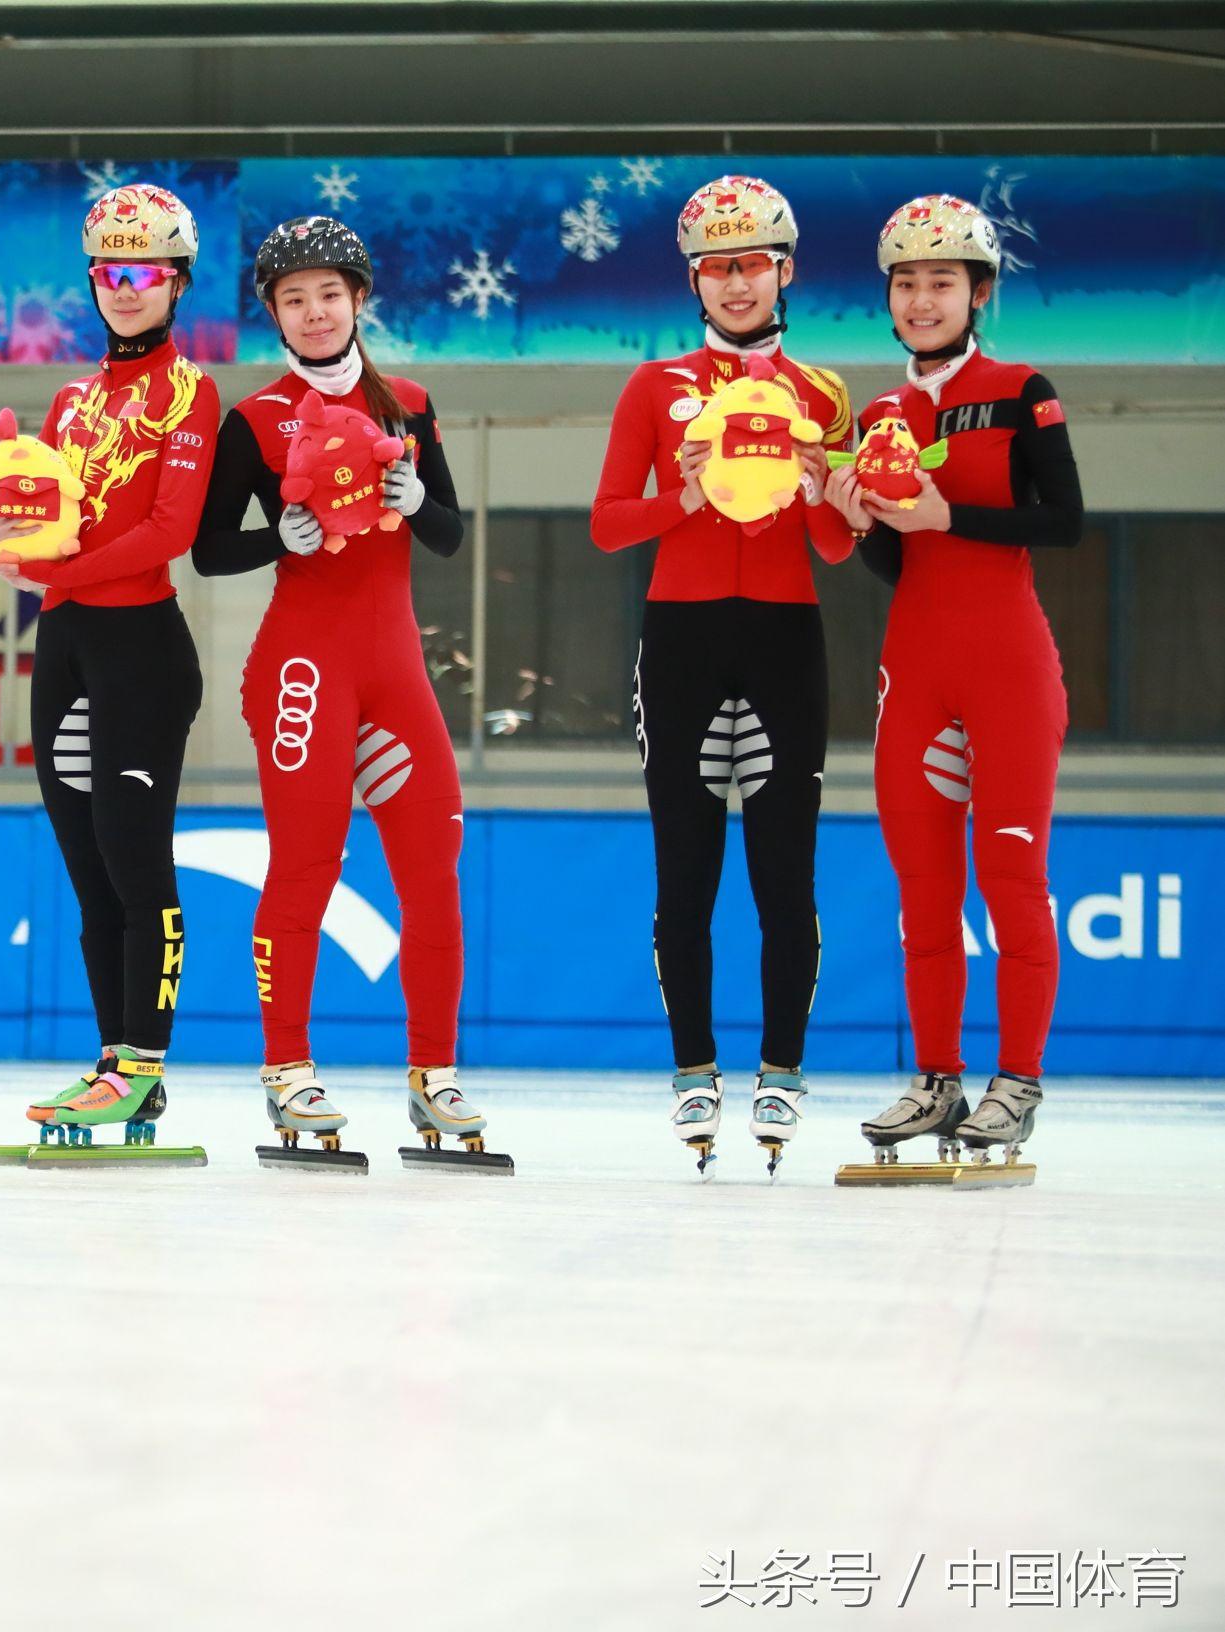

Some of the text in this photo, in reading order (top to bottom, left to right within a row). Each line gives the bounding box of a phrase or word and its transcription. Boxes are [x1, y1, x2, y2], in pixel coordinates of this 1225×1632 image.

[939, 402, 995, 438] CHN
[733, 444, 782, 456] 恭喜发财
[330, 483, 374, 510] 恭喜发财
[0, 503, 47, 516] 恭喜发财
[157, 906, 185, 1011] CHN
[135, 1064, 156, 1073] BEST
[260, 1074, 282, 1083] pex
